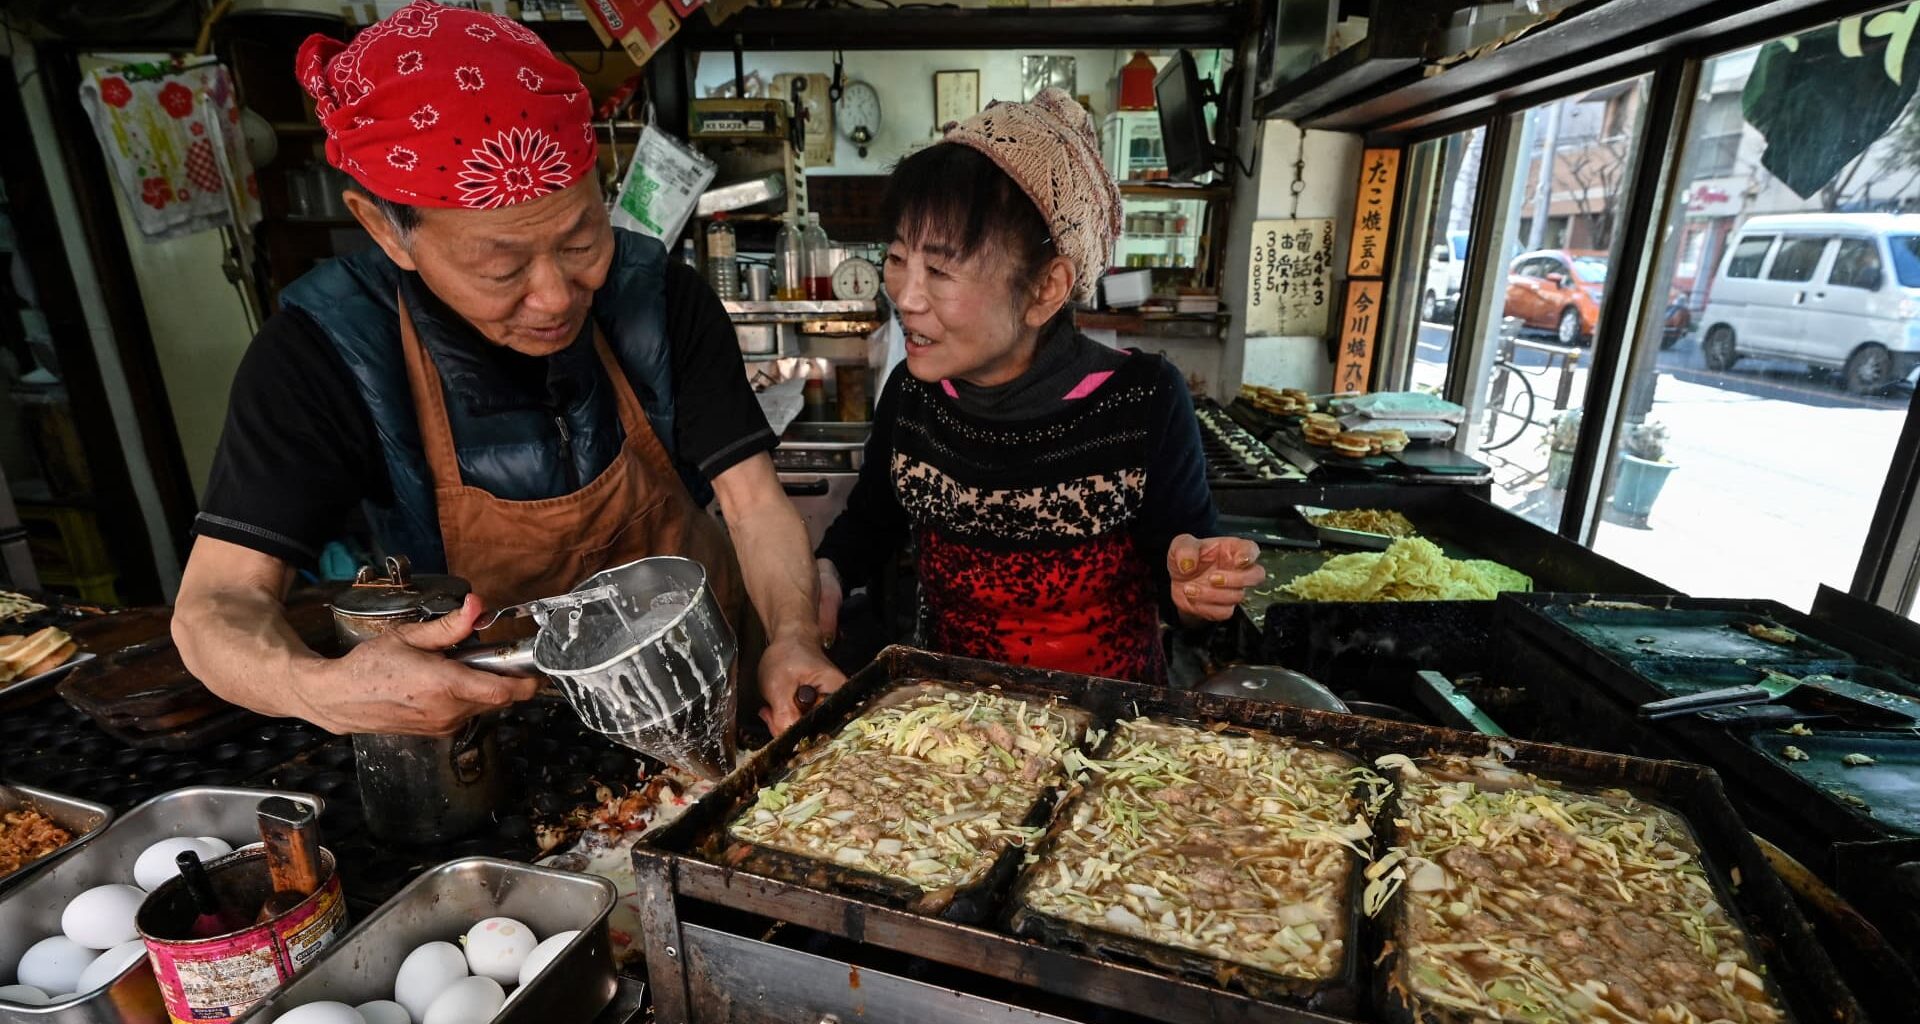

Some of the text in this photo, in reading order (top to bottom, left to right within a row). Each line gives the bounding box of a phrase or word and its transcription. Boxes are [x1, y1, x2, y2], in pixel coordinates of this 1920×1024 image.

[1252, 246, 1263, 307] 3853
[1266, 230, 1277, 291] 3875
[1291, 228, 1314, 319] 電話注文
